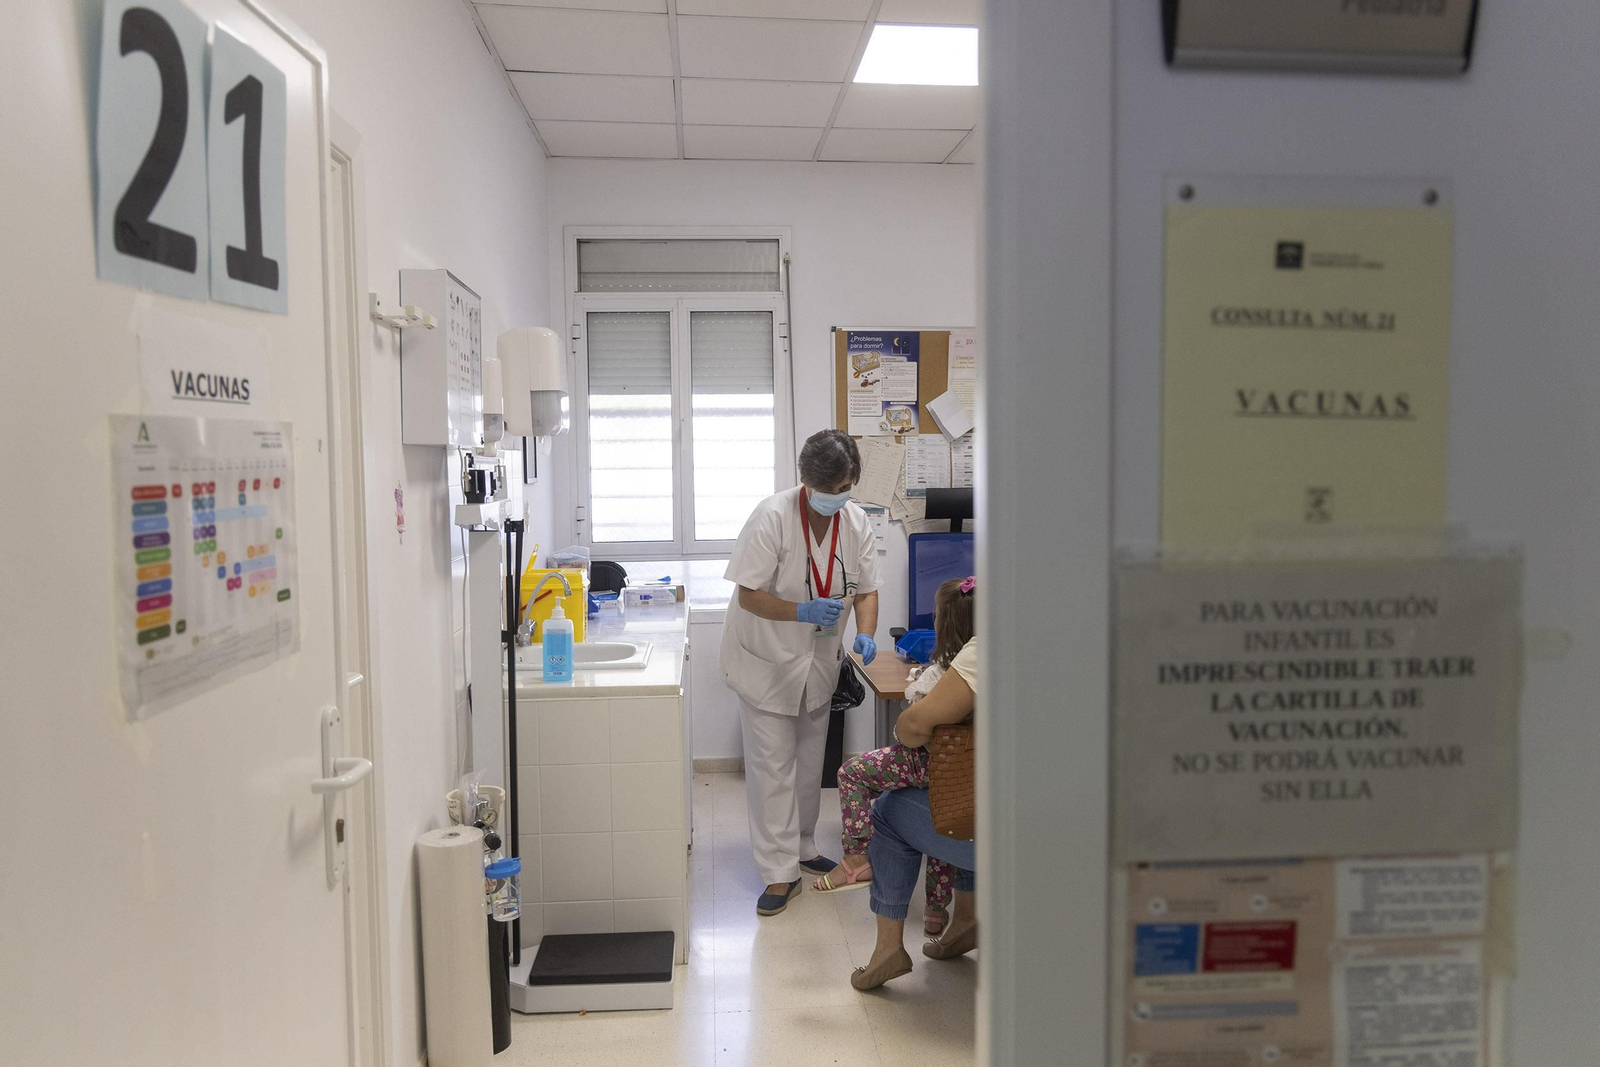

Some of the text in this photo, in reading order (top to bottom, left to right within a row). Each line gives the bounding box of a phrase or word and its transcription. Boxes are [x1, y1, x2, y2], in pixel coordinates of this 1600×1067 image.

[113, 7, 279, 291] 21
[1211, 307, 1313, 326] CONSULTA
[1378, 312, 1395, 330] 21
[850, 335, 882, 343] ¿Problemas
[171, 369, 250, 400] VACUNAS
[1236, 388, 1411, 417] VACUNAS
[1199, 595, 1438, 623] PARA VACUNACIÓN
[1244, 628, 1395, 653] INFANTIL ES
[1158, 655, 1476, 685] IMPRESCINDIBLE TRAER
[1210, 687, 1425, 713] LA CARTILLA DE
[1227, 714, 1408, 742] VACUNACIÓN.
[1171, 744, 1466, 775] NO SE PODRÁ VACUNAR
[1260, 778, 1374, 803] SIN ELLA
